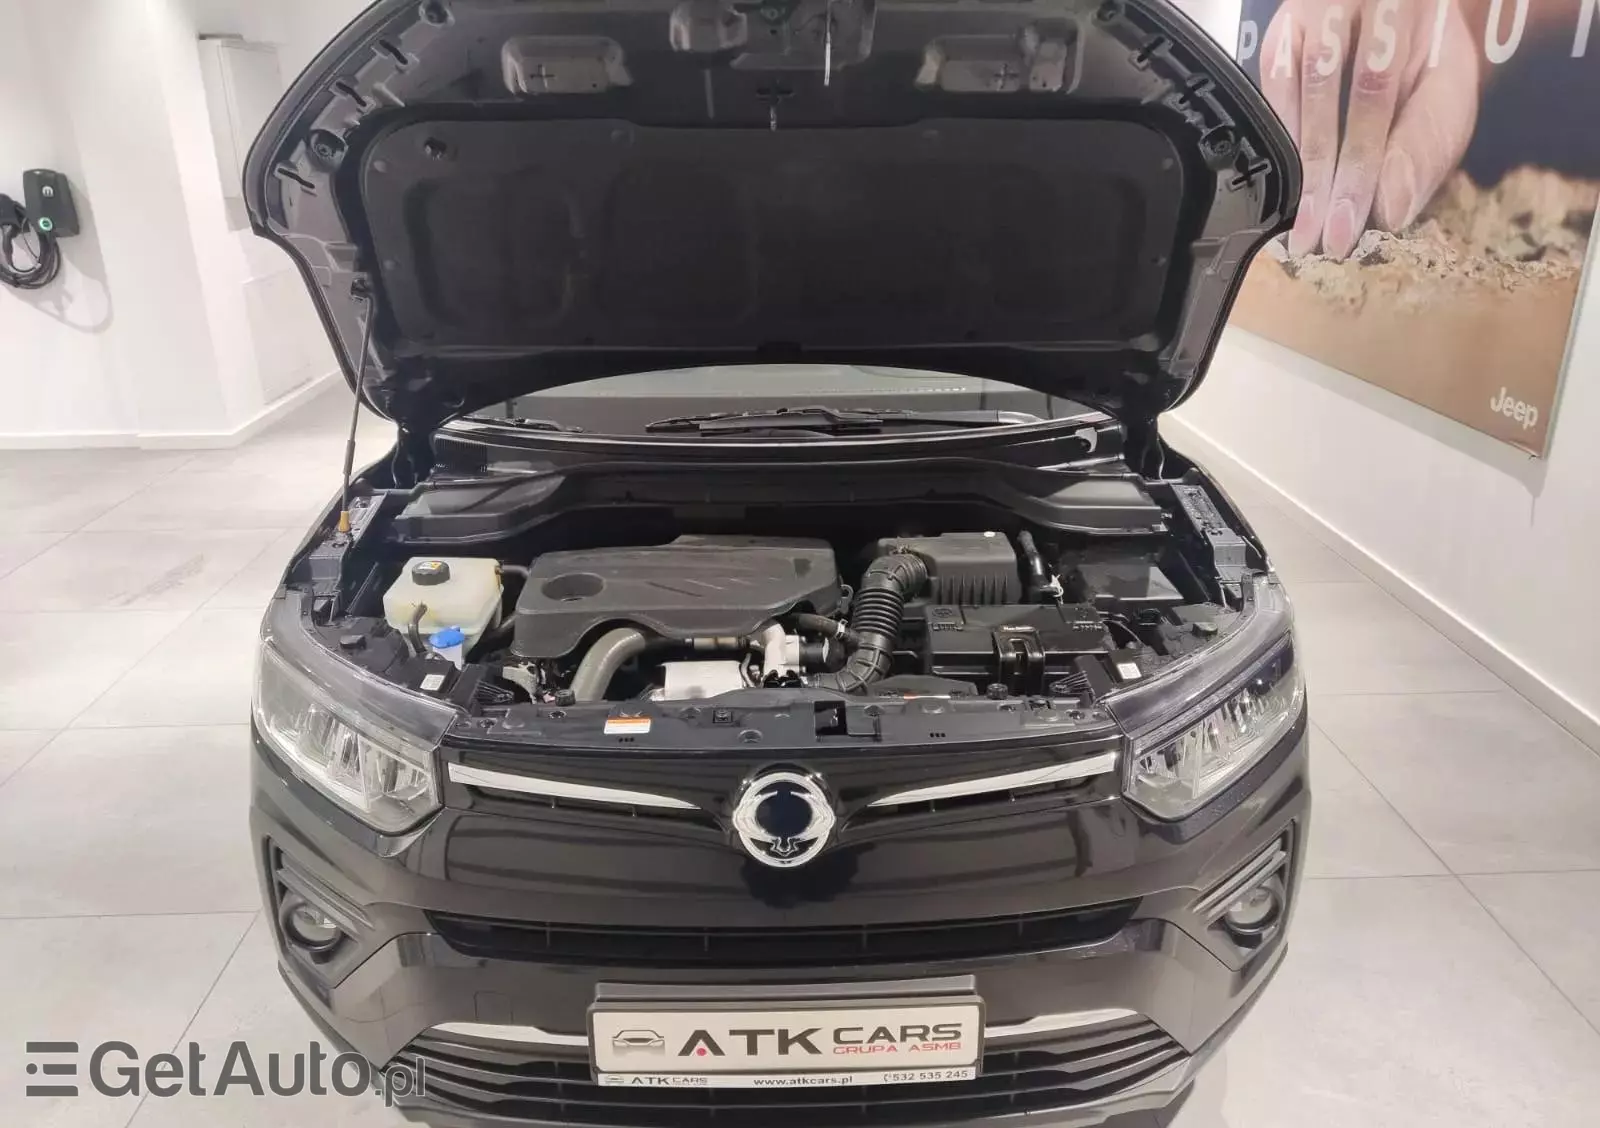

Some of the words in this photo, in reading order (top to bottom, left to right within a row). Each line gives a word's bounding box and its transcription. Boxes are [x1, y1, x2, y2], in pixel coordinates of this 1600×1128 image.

[1236, 0, 1600, 79] PASSIO
[1490, 386, 1538, 430] Jeep
[677, 1028, 823, 1057] ATK
[833, 1023, 962, 1044] CARS
[833, 1045, 898, 1055] GRUPA
[908, 1042, 962, 1052] ASMB
[631, 1076, 670, 1085] ATK
[672, 1077, 708, 1086] CARS
[753, 1075, 853, 1086] www.atkcars.pl
[919, 1071, 942, 1080] 535
[946, 1070, 968, 1079] 245
